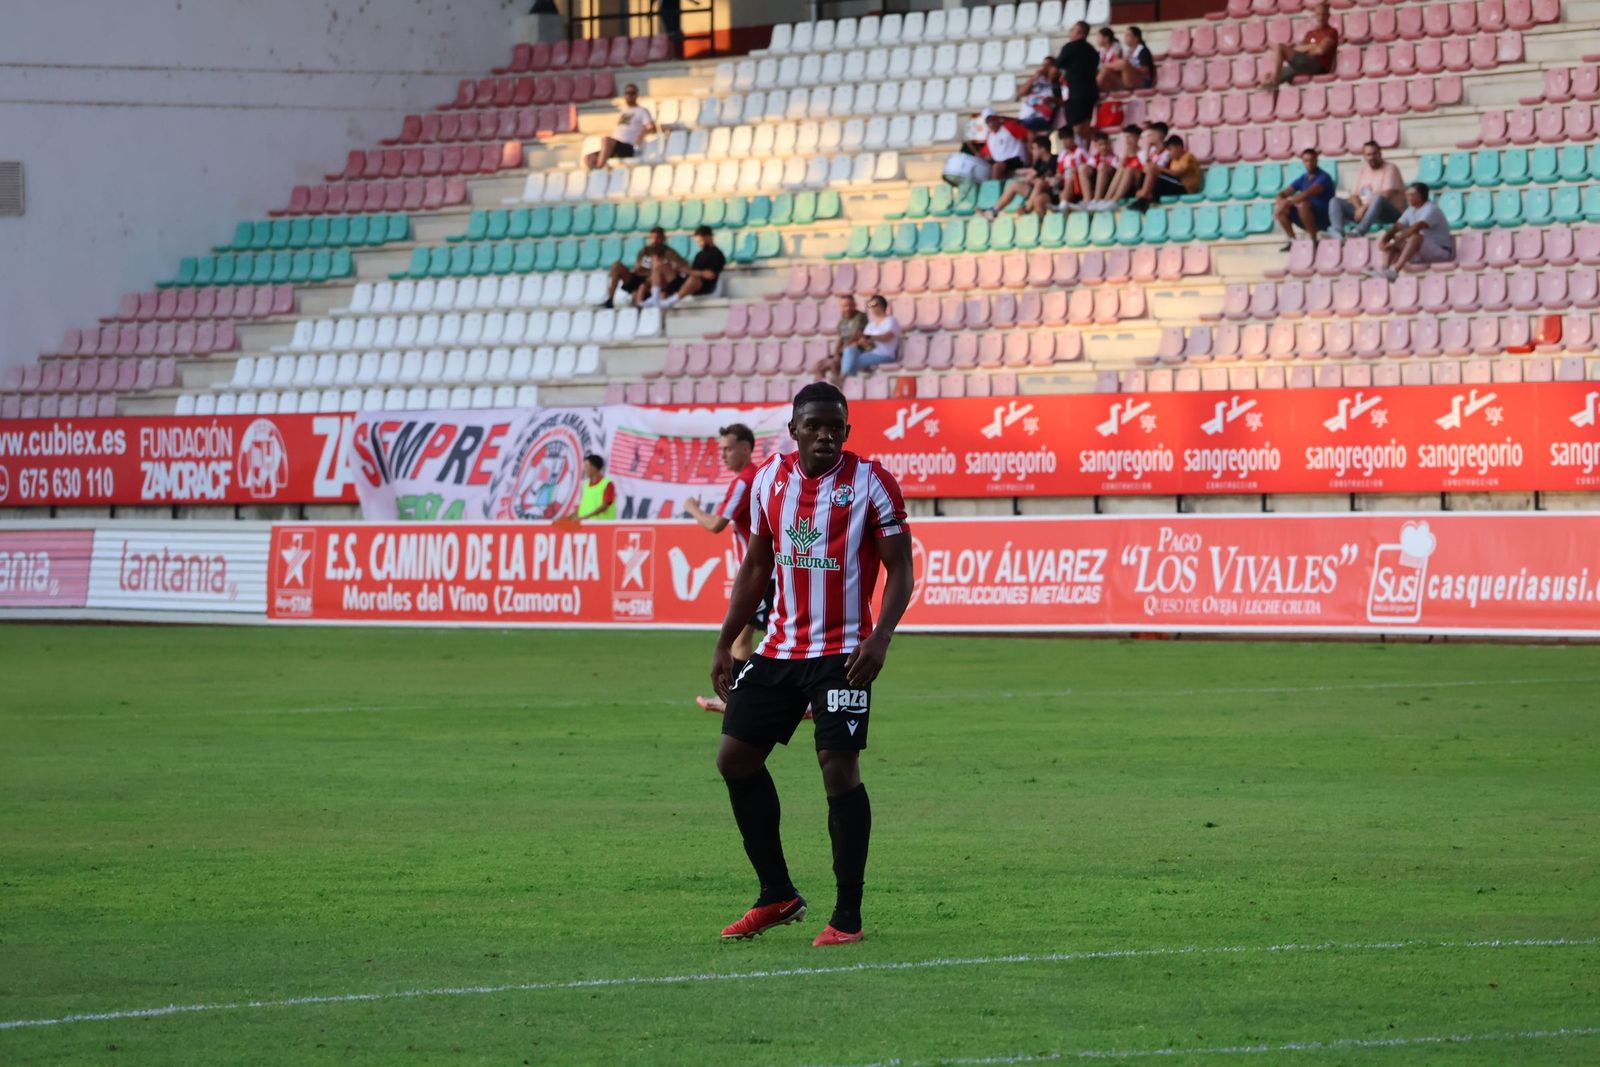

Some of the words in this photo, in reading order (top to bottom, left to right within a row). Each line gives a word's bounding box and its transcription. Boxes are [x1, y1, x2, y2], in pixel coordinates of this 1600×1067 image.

[1485, 406, 1504, 427] sgc
[140, 419, 232, 458] FUNDACIÓN
[1418, 436, 1523, 475] sangregorio
[965, 444, 1056, 481] sangregorio
[1080, 443, 1173, 480] sangregorio
[1184, 441, 1281, 479] sangregorio
[1305, 438, 1407, 477] sangregorio
[20, 468, 48, 498] 675
[53, 467, 81, 498] 630
[87, 467, 114, 497] 110
[119, 539, 228, 593] lantania
[325, 533, 363, 580] E.S.
[369, 532, 460, 581] CAMINO
[464, 533, 494, 581] DE
[498, 533, 526, 581] LA
[532, 533, 600, 581] PLATA
[796, 555, 840, 571] RURAL
[925, 549, 993, 584] ELOY
[994, 541, 1108, 583] ÁLVAREZ
[343, 582, 412, 611] Morales
[416, 582, 444, 611] del
[448, 586, 489, 612] Vino
[493, 585, 581, 615] (Zamora)
[1030, 582, 1102, 605] METÁLICAS
[1374, 566, 1420, 602] Susi
[827, 689, 868, 713] gaza
